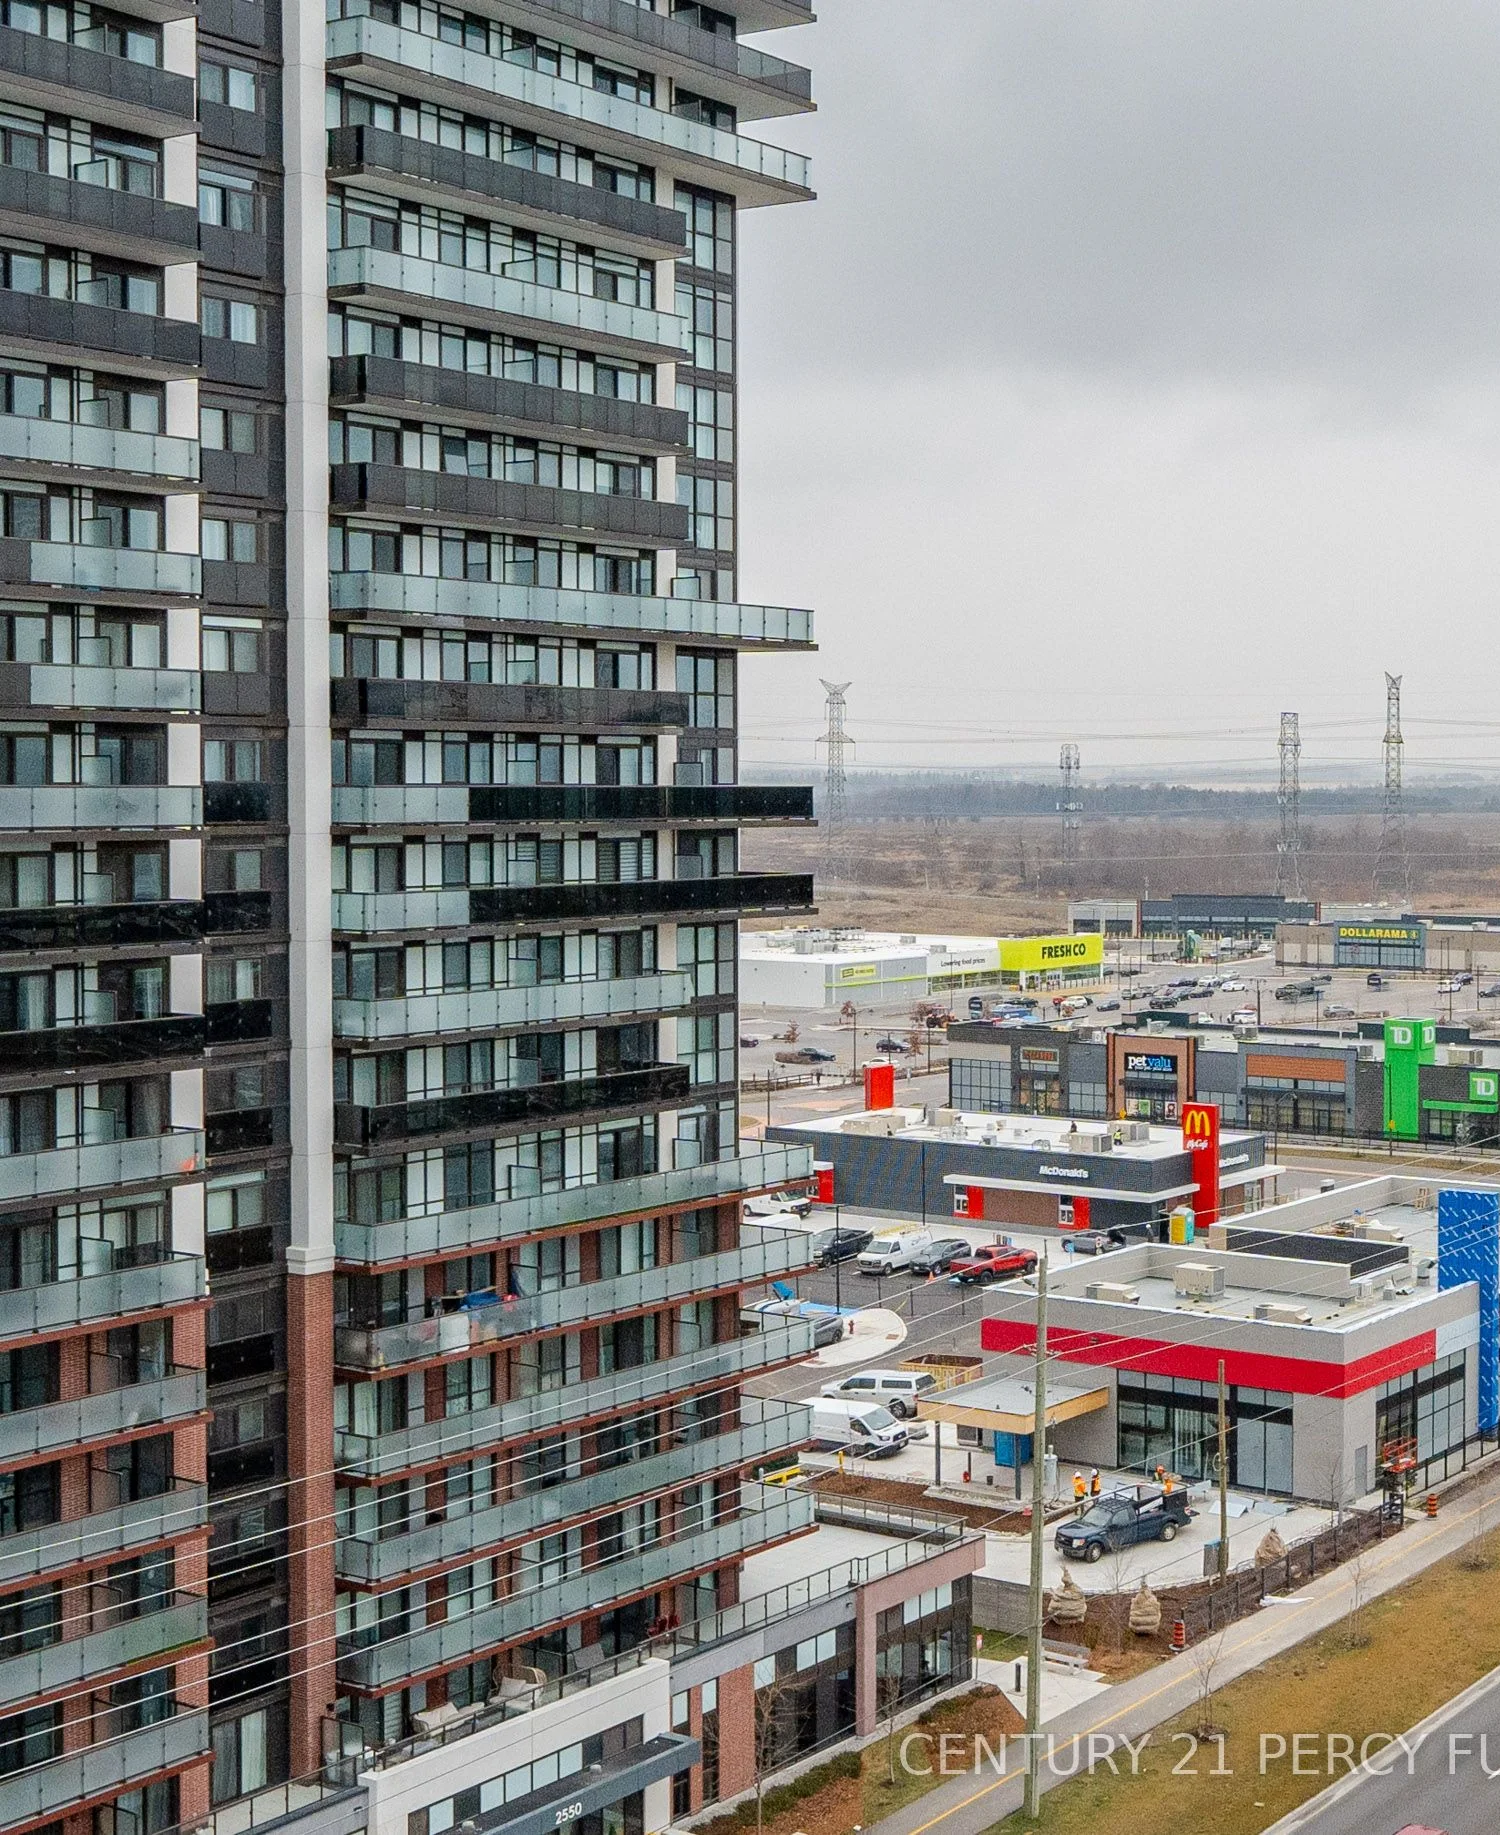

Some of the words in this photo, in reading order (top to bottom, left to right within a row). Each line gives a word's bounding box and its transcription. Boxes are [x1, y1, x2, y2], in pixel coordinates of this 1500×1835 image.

[1339, 927, 1408, 939] DOLLARAMA
[1389, 1026, 1412, 1045] TD
[1422, 1026, 1435, 1044] TD
[1472, 1077, 1496, 1096] TD
[1039, 1165, 1089, 1179] McDonald's
[555, 1802, 582, 1825] 2550
